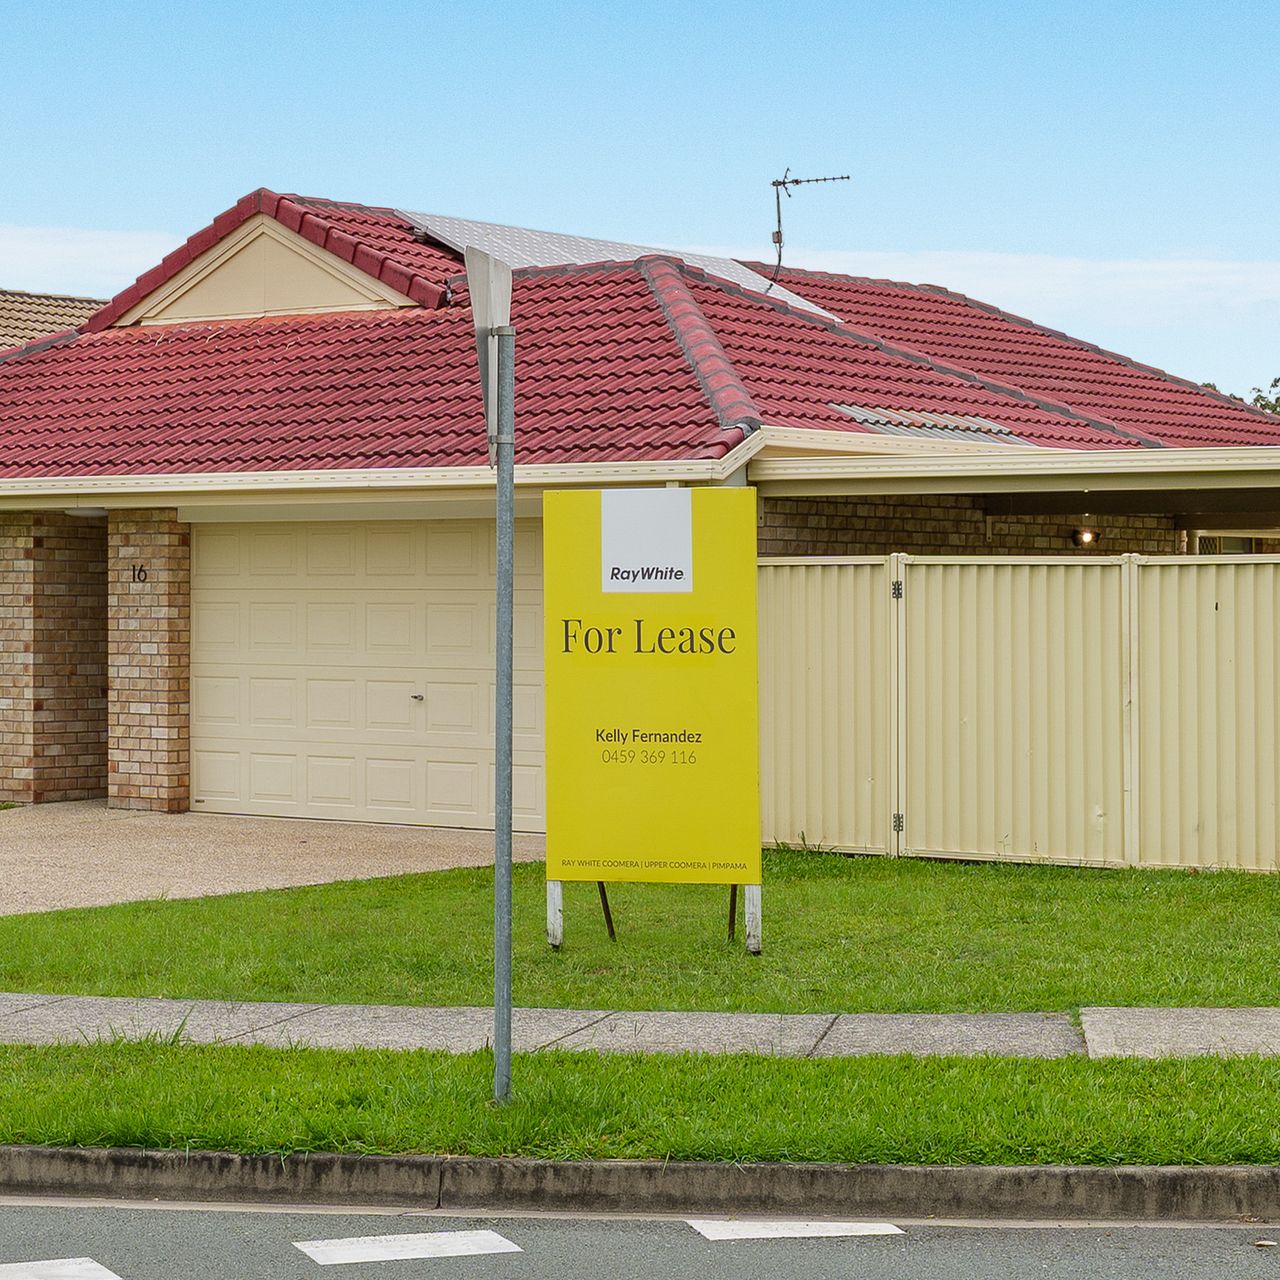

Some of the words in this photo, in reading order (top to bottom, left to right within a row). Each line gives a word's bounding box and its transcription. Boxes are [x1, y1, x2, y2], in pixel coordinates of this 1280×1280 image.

[132, 564, 148, 583] 16
[561, 619, 622, 654] For
[633, 619, 736, 654] Lease
[596, 729, 628, 745] Kelly
[632, 729, 702, 743] Fernandez
[601, 749, 636, 764] 0459
[640, 750, 666, 765] 369
[671, 750, 697, 765] 116
[561, 858, 576, 867] RAY
[577, 859, 601, 868] WHITE
[602, 859, 640, 869] COOMERA
[644, 860, 668, 869] UPPER
[669, 860, 707, 869] COOMERA
[712, 861, 748, 871] PIMPAMA
